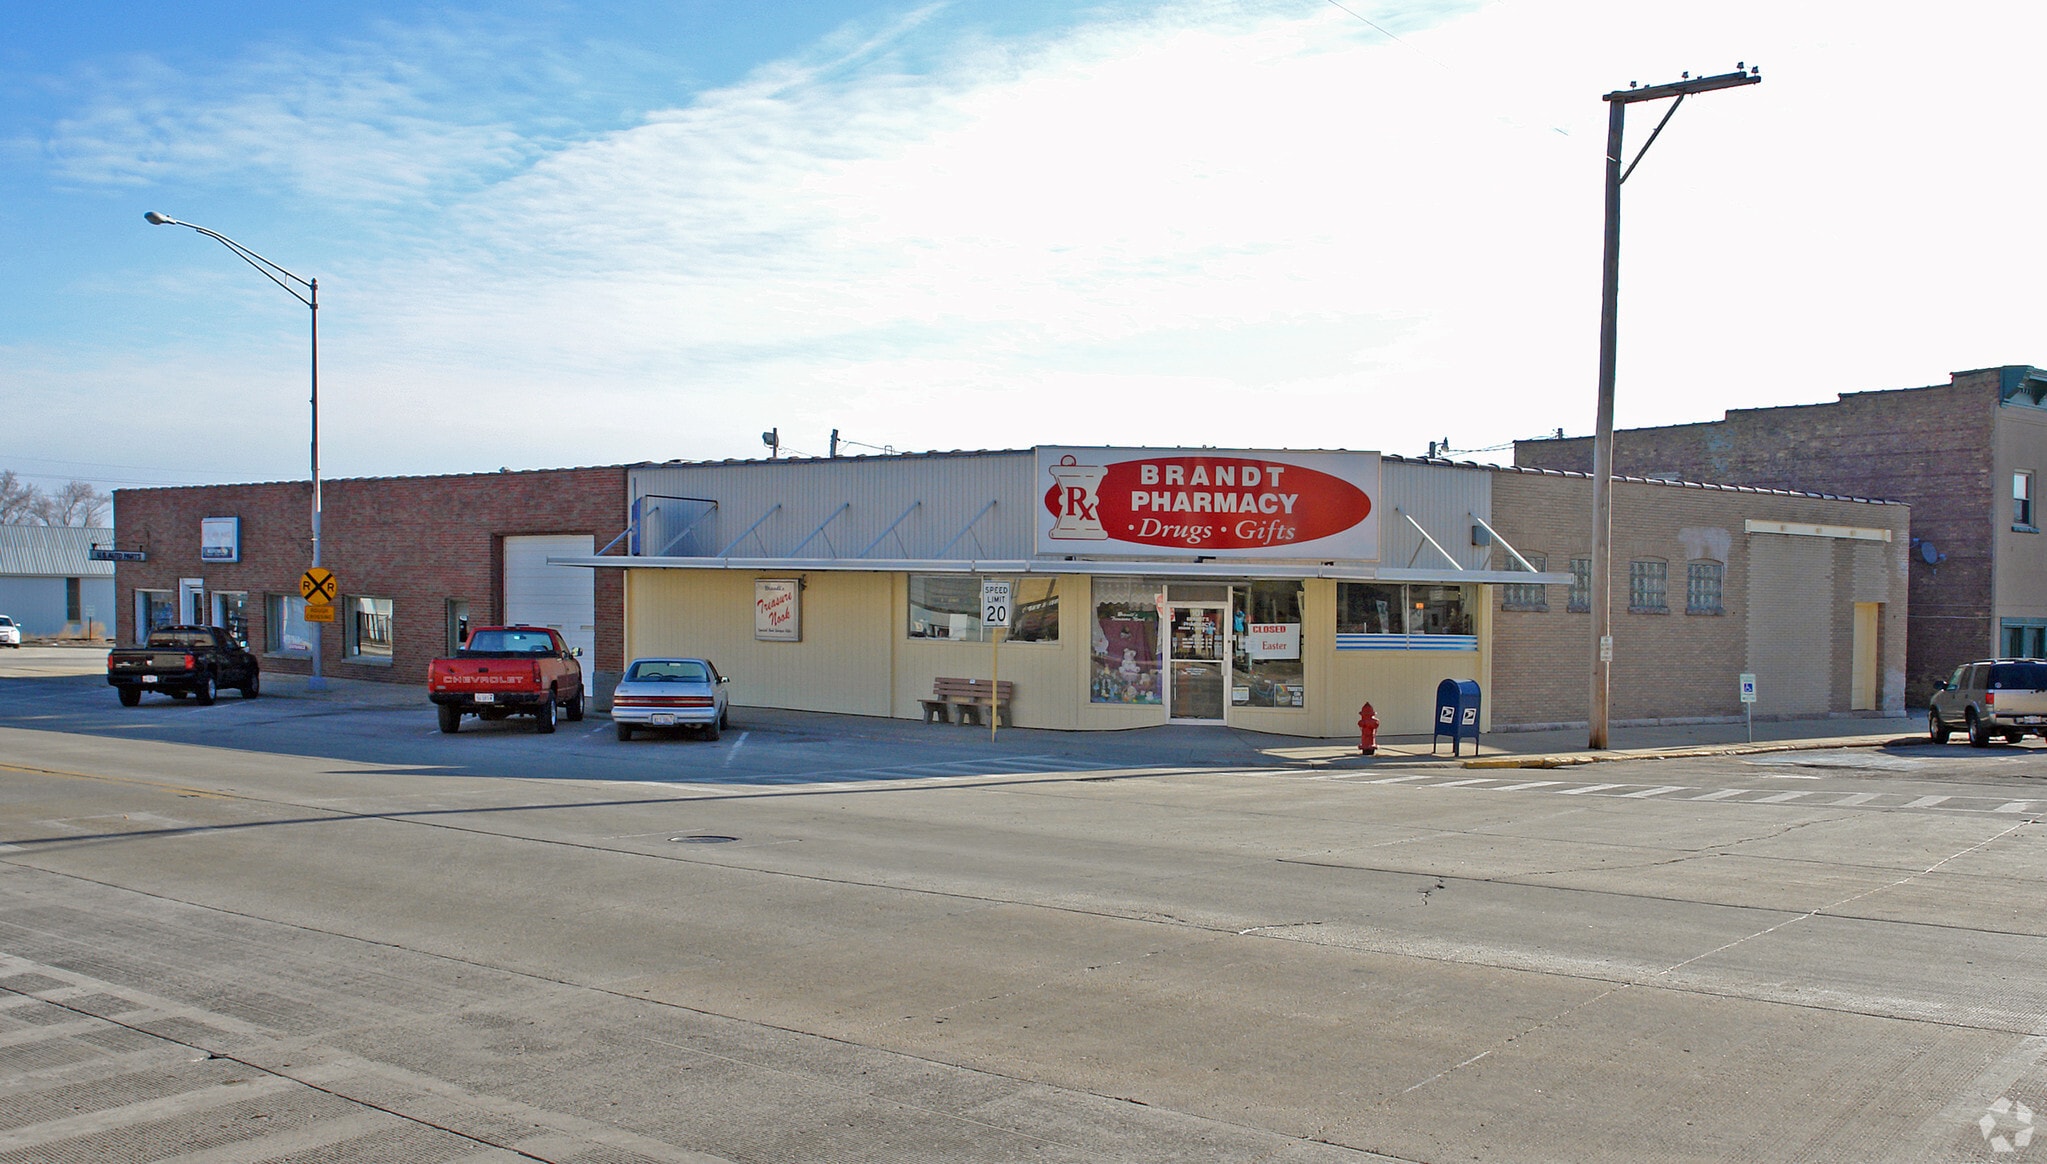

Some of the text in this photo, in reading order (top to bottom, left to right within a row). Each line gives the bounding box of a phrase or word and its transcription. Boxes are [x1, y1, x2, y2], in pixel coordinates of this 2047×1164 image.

[1140, 464, 1285, 488] BRANDT
[1131, 491, 1299, 514] PHARMACY
[1137, 518, 1297, 545] Drugs Gifts
[303, 581, 335, 592] R R
[985, 586, 1008, 594] SPEED
[757, 592, 792, 614] Treasure
[769, 606, 790, 626] Nook
[987, 605, 1006, 622] 20
[1252, 625, 1287, 634] CLOSED
[1262, 640, 1287, 651] Easter
[443, 676, 524, 684] CHEVROLET
